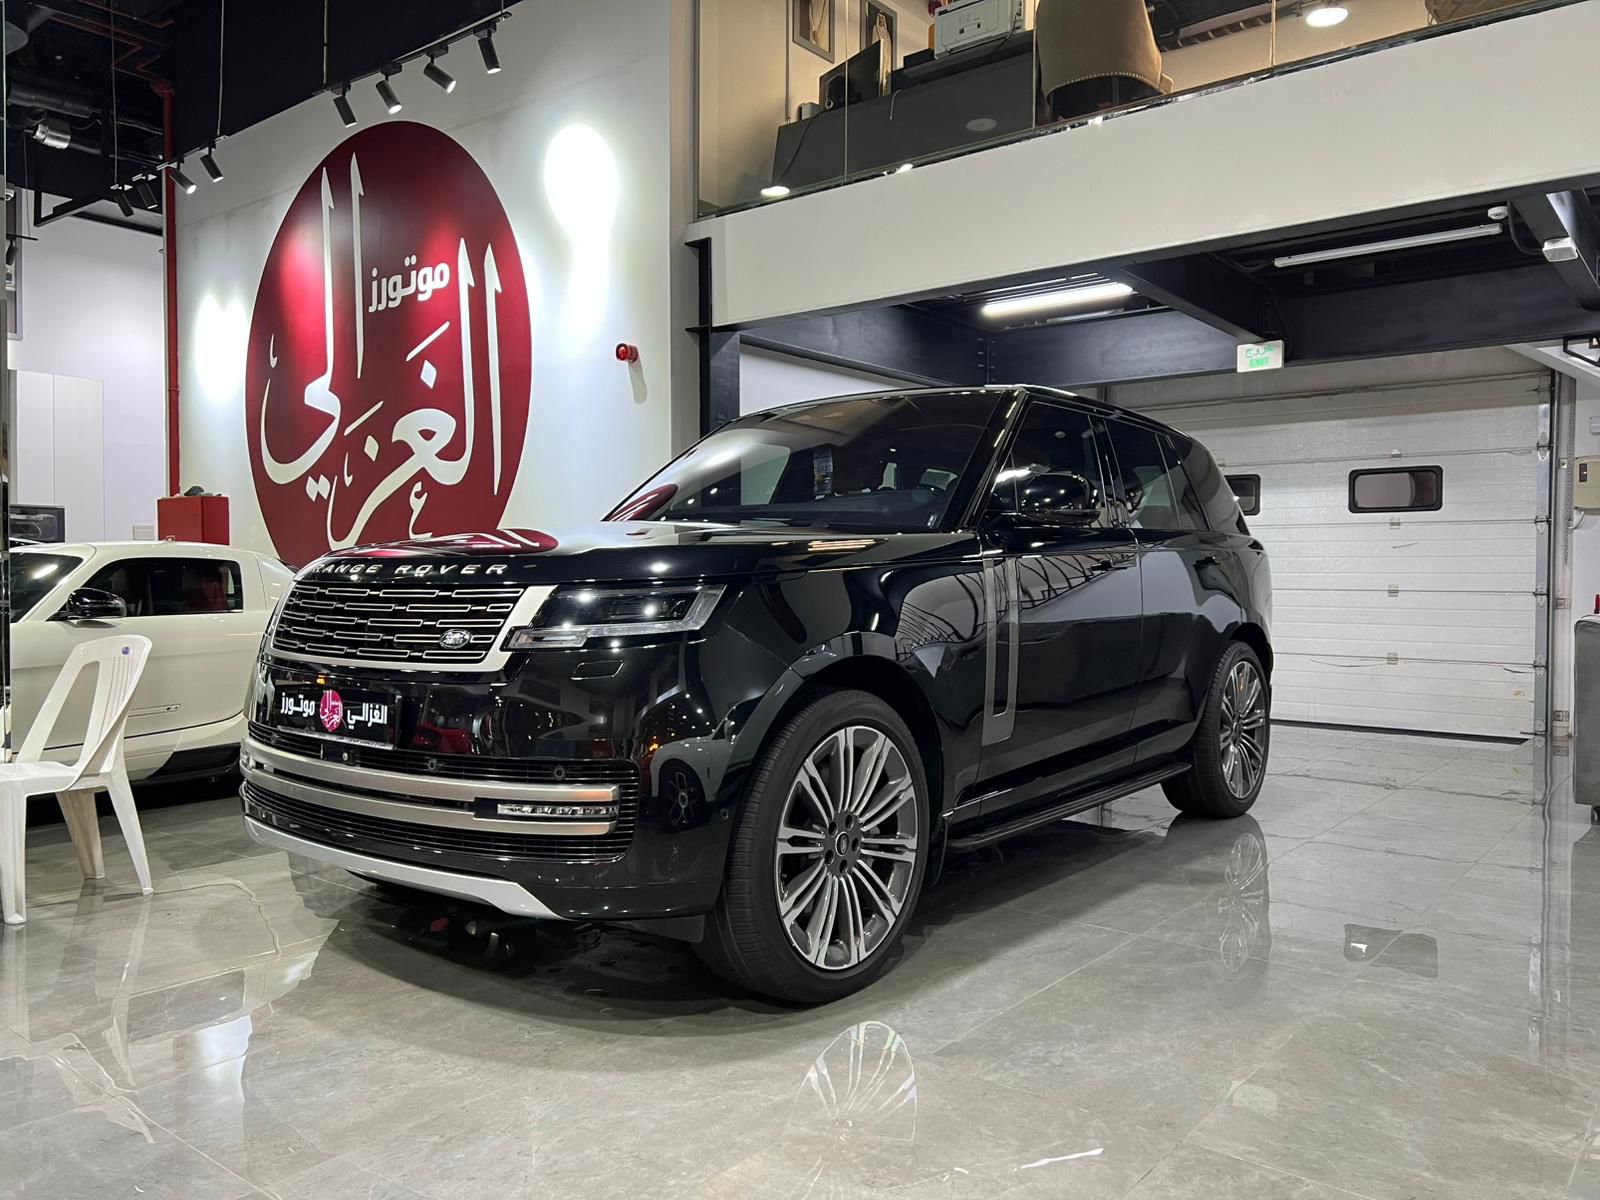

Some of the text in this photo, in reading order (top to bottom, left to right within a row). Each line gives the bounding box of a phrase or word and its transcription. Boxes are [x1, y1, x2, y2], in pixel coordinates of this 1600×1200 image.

[368, 255, 450, 313] موتورز
[311, 563, 509, 576] RANGE ROVER
[280, 692, 316, 717] موتورز
